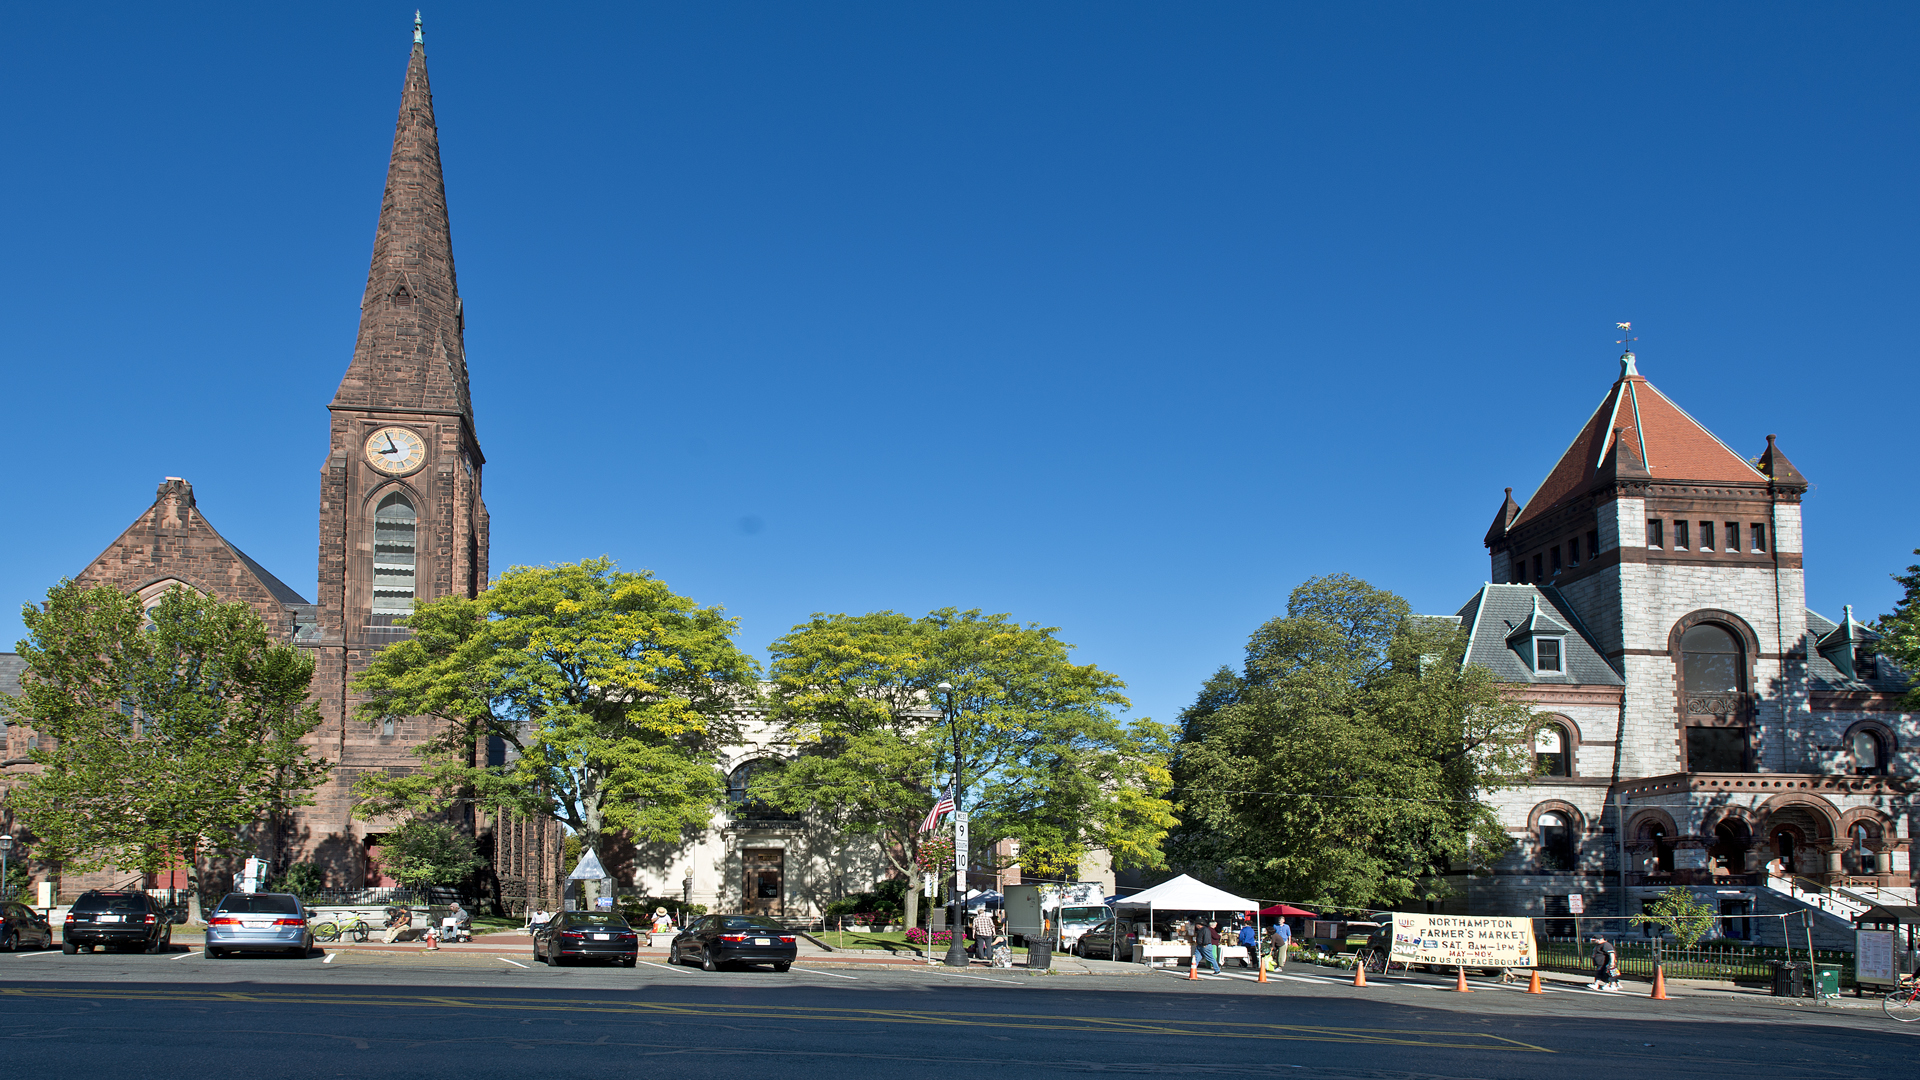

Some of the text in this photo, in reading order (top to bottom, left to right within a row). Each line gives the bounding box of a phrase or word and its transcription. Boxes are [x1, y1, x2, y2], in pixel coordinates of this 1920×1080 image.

[959, 825, 965, 837] 9
[958, 854, 966, 867] 10
[1428, 917, 1512, 928] NORTHAMPTON
[1420, 929, 1525, 939] FARMER'S MARKET
[1392, 944, 1418, 955] SNAP
[1441, 941, 1463, 949] SAT.
